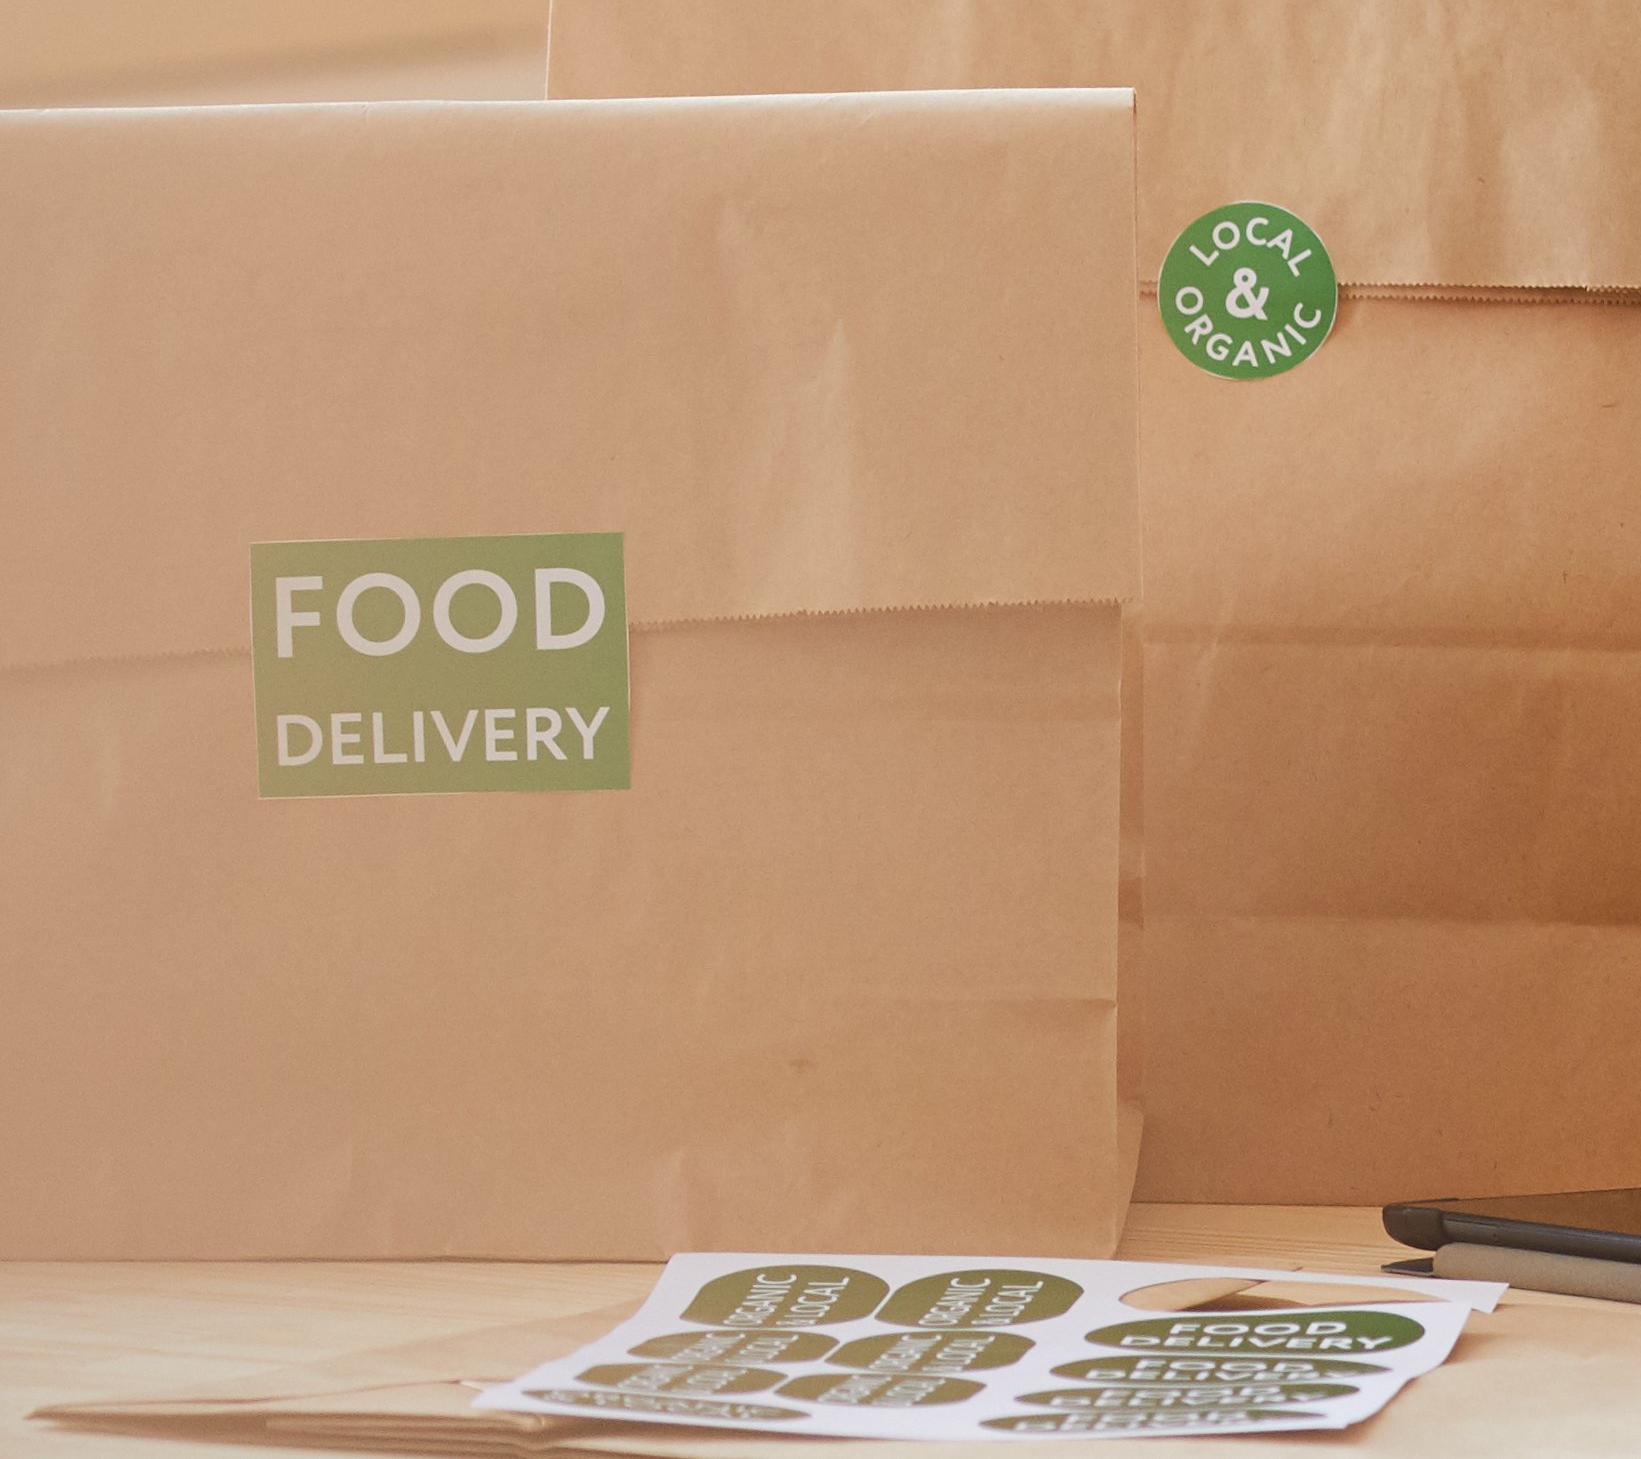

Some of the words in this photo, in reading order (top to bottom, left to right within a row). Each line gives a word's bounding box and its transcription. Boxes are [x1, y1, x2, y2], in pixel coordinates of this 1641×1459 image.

[1188, 216, 1313, 278] LOCAL
[1225, 266, 1270, 321] &
[1175, 285, 1322, 368] ORGANIC
[275, 567, 606, 658] FOOD
[276, 706, 611, 767] DELIVERY
[783, 1276, 850, 1318] LOCAL
[979, 1280, 1044, 1318] LOCAL
[1120, 1335, 1393, 1350] DELIVERY
[1169, 1321, 1347, 1335] FOOD
[1136, 1358, 1314, 1372] FOOD
